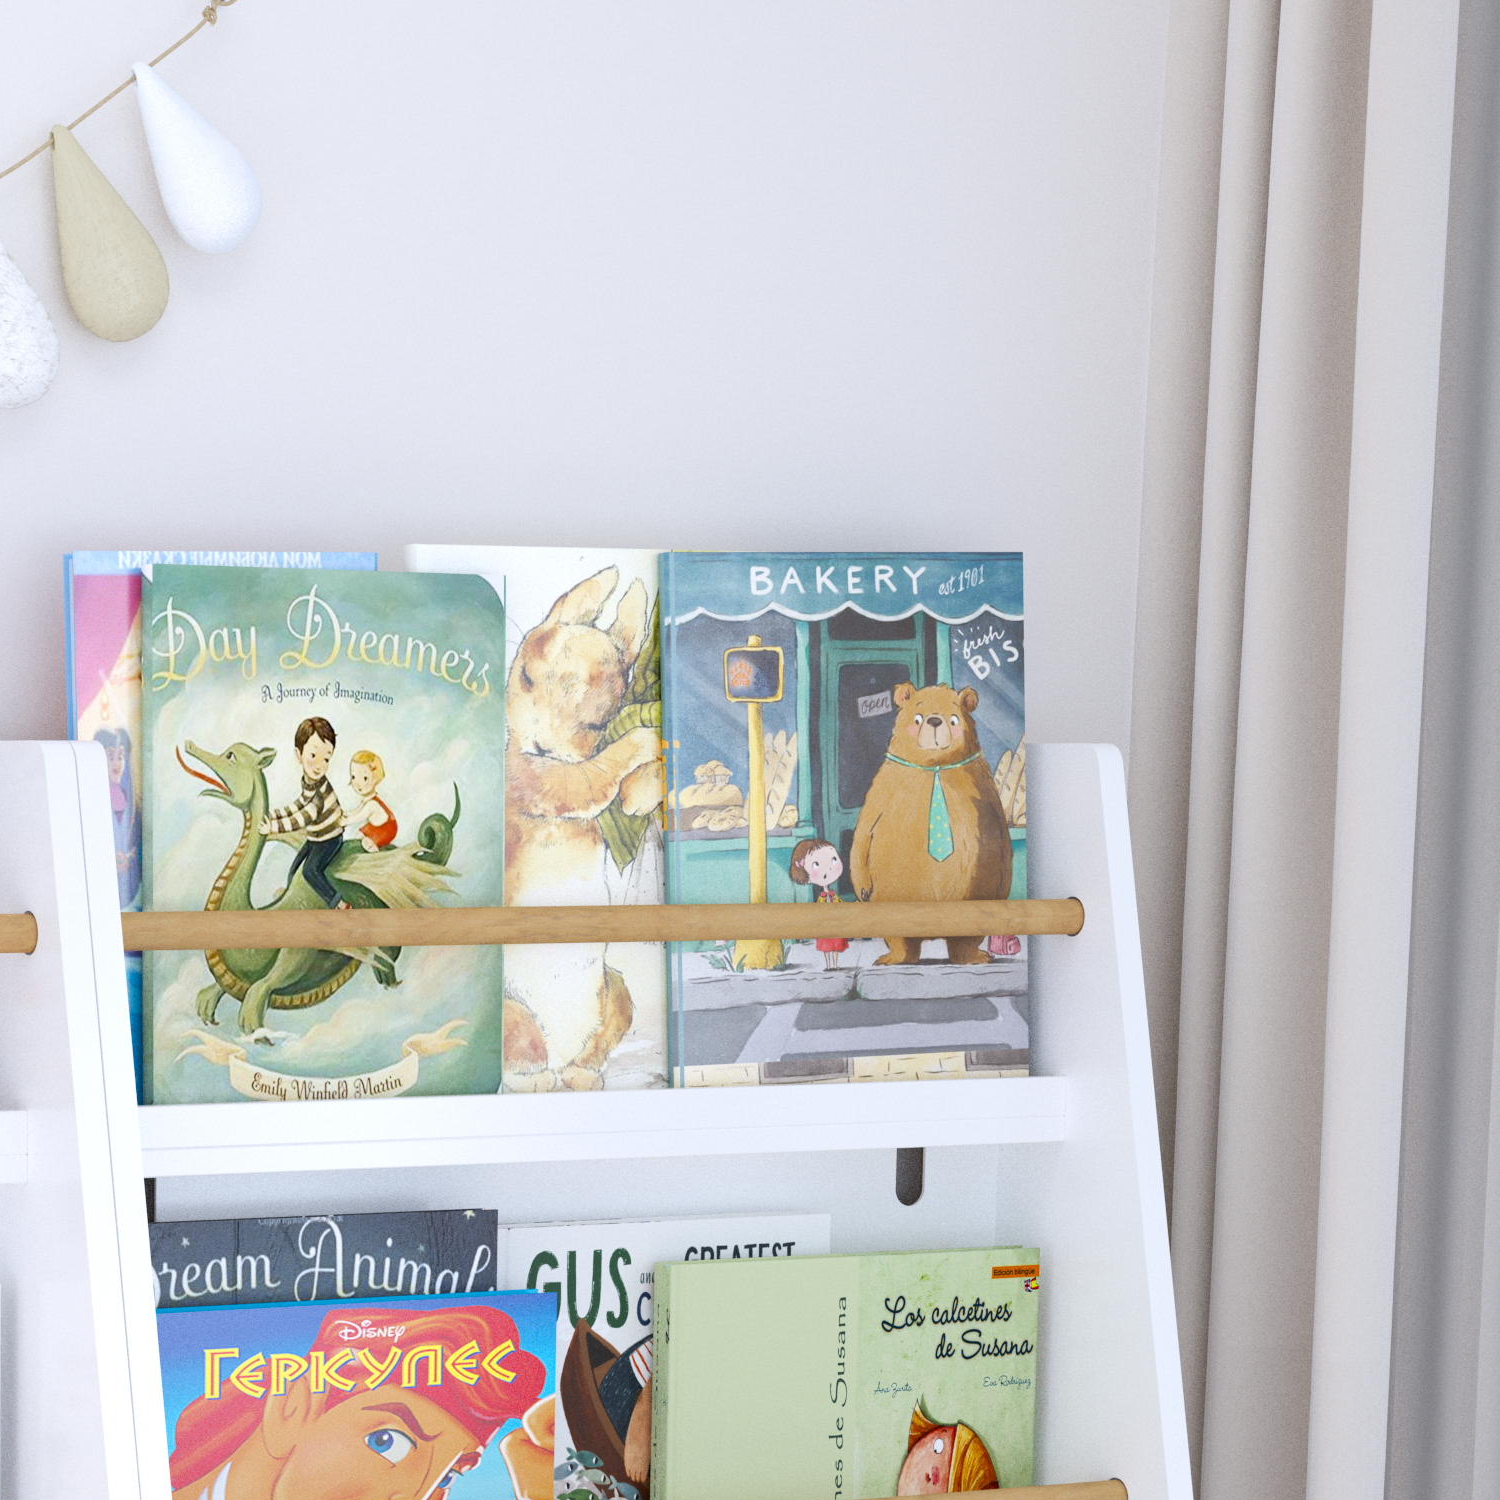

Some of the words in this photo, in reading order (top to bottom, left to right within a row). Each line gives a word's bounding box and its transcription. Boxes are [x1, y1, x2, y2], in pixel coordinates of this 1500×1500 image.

[750, 565, 926, 596] BAKERY
[938, 580, 957, 596] est
[957, 564, 986, 592] 1901
[152, 596, 257, 692] Day
[280, 584, 490, 698] Dreamers
[963, 630, 1004, 660] fresh
[261, 685, 273, 703] A
[276, 682, 317, 703] Journey
[319, 682, 331, 697] of
[333, 681, 394, 705] Imagination
[251, 1072, 287, 1100] Emily
[291, 1079, 348, 1100] Winfield
[354, 1075, 403, 1098] Martin
[150, 1252, 281, 1308] ream
[294, 1218, 496, 1302] Animal
[526, 1247, 632, 1328] GUS
[881, 1296, 926, 1332] Los
[931, 1296, 1013, 1325] calcetines
[829, 1296, 848, 1408] Susana
[935, 1333, 955, 1360] de
[961, 1328, 1034, 1360] Susana
[203, 1339, 517, 1401] ГЕРКУЛЕС
[828, 1416, 844, 1450] de
